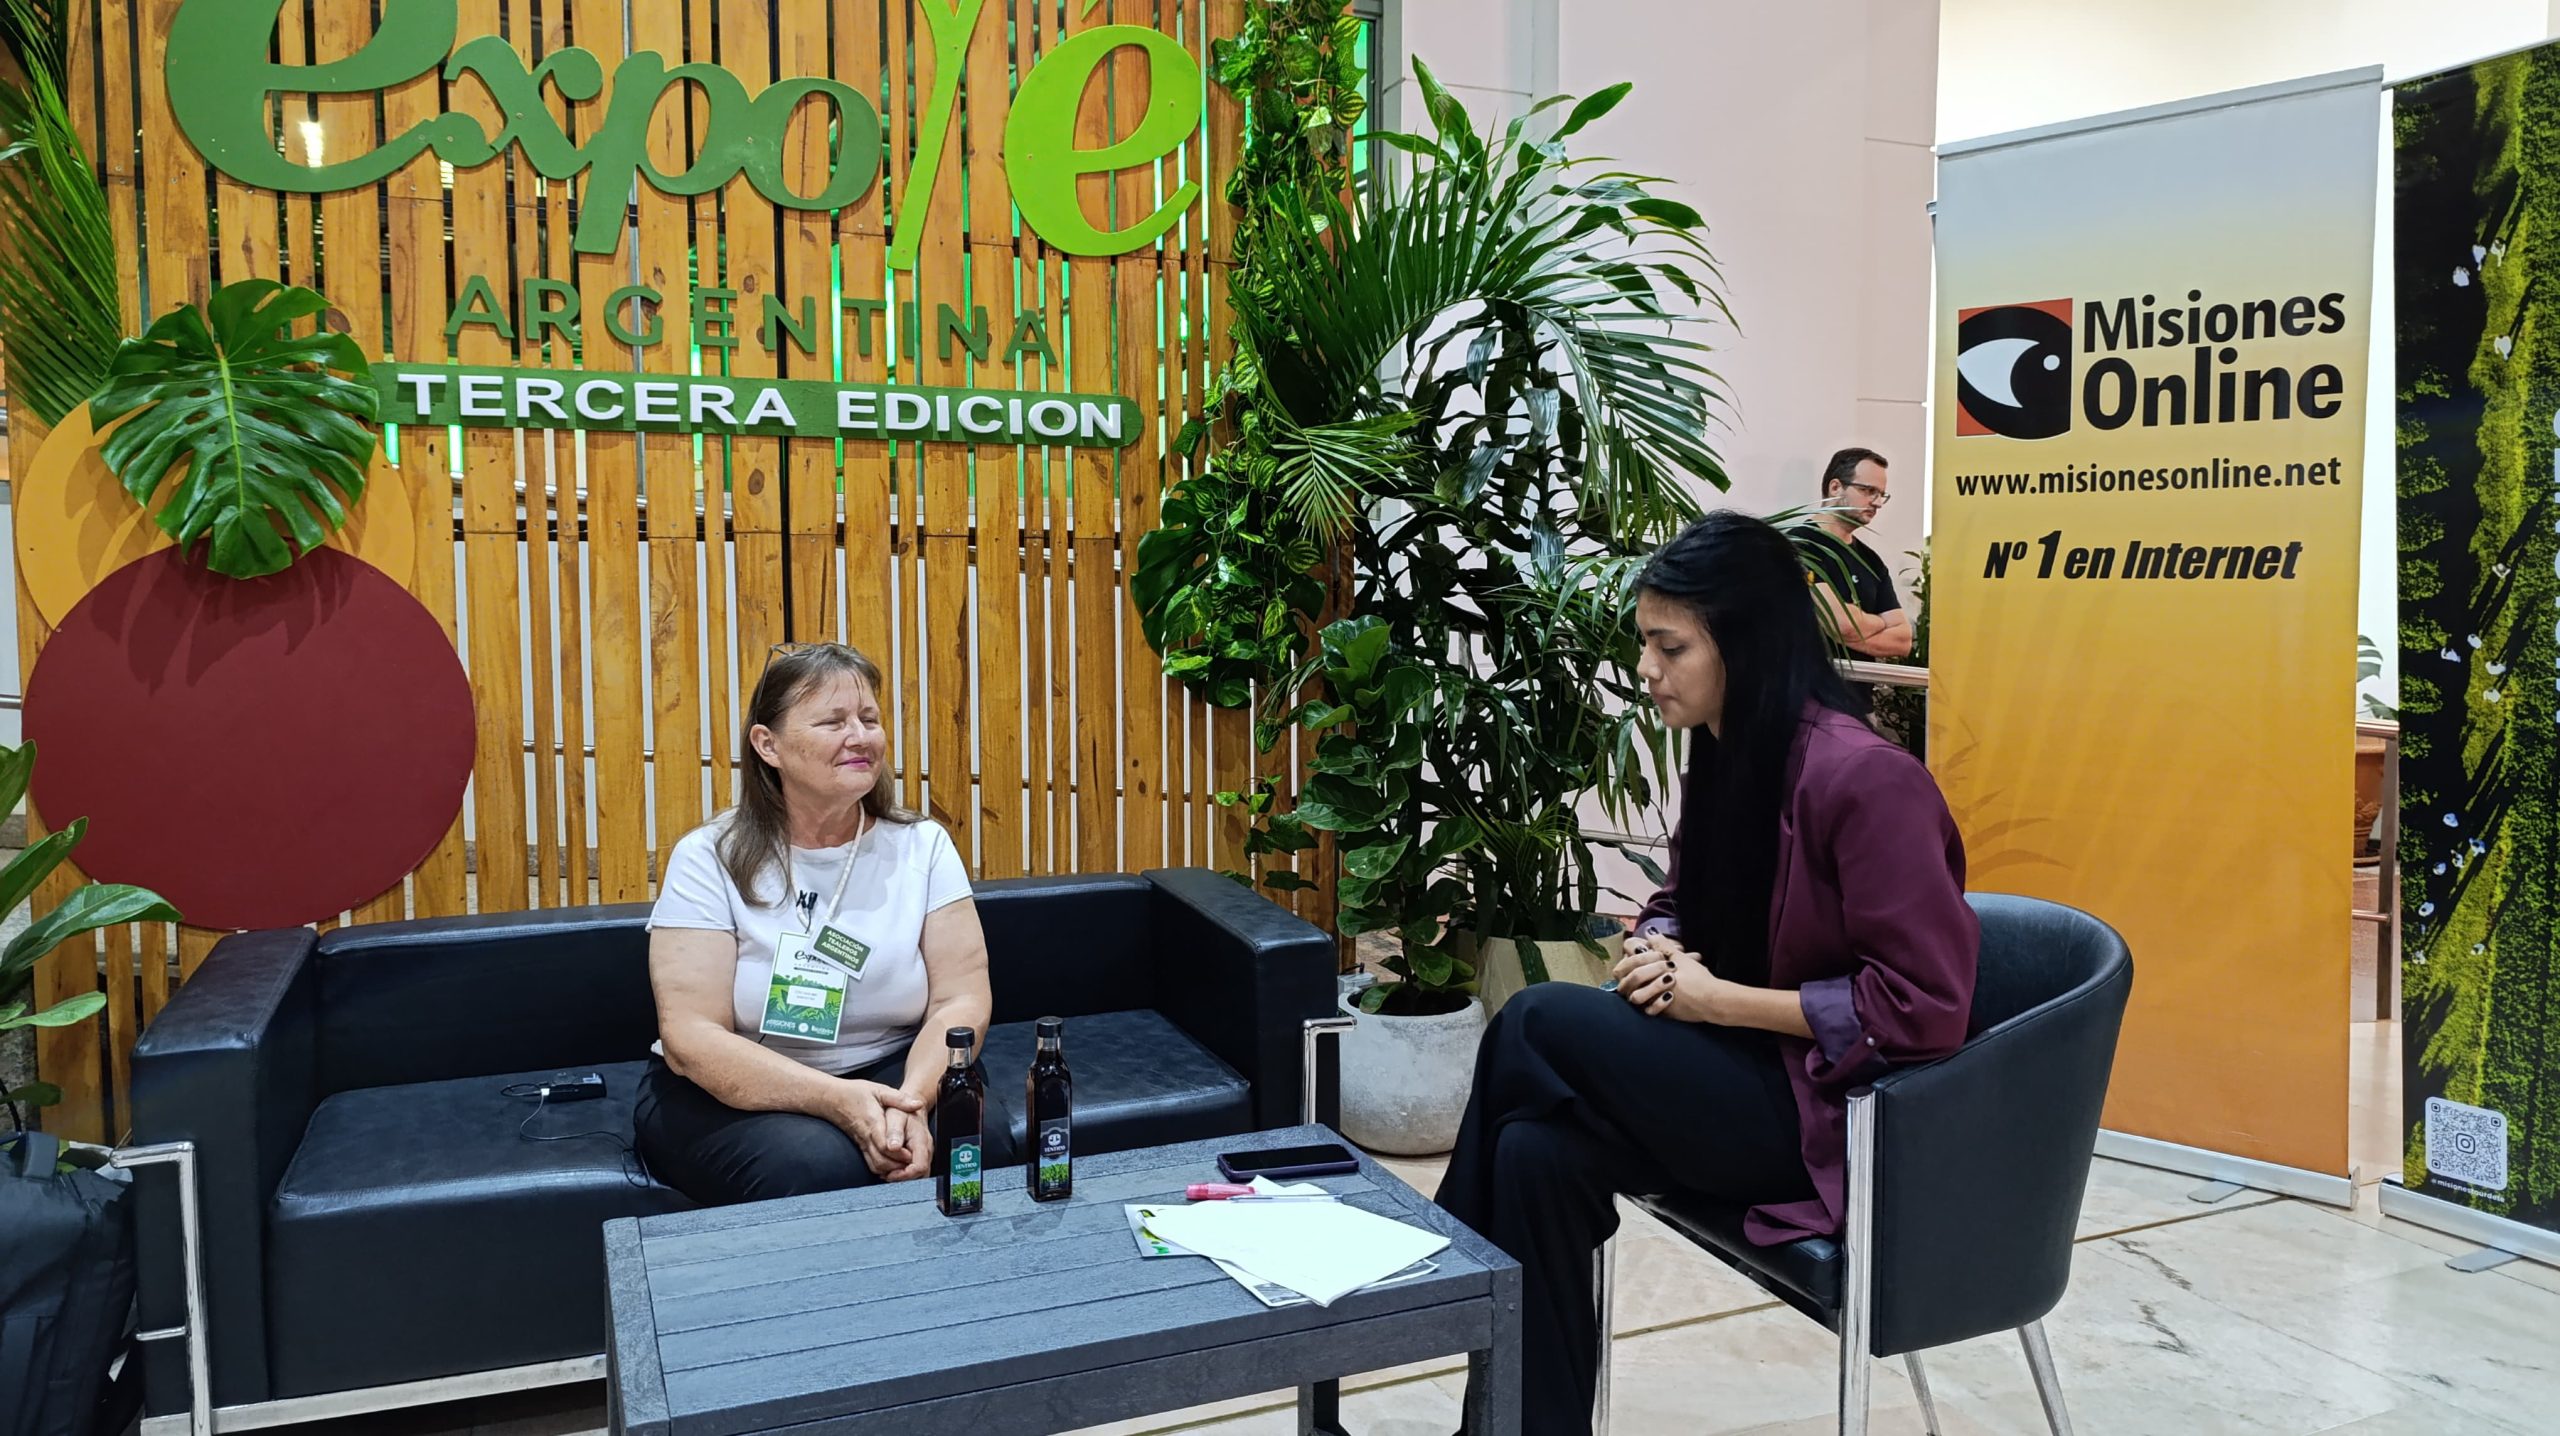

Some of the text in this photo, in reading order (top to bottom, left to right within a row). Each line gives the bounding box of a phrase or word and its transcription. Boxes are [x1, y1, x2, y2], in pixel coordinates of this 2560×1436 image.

[445, 274, 1058, 365] ARGENTINA
[2083, 290, 2346, 353] Misiones
[398, 373, 1122, 439] TERCERA EDICION
[2083, 347, 2344, 430] Online
[1956, 456, 2341, 495] www.misionesonline.net
[2036, 530, 2061, 579] 1
[2063, 547, 2117, 579] en
[2121, 540, 2302, 580] Internet
[821, 941, 860, 964] ARGENTINOS
[826, 930, 864, 952] ASOCIACIÓN
[828, 937, 858, 956] TEALEROS
